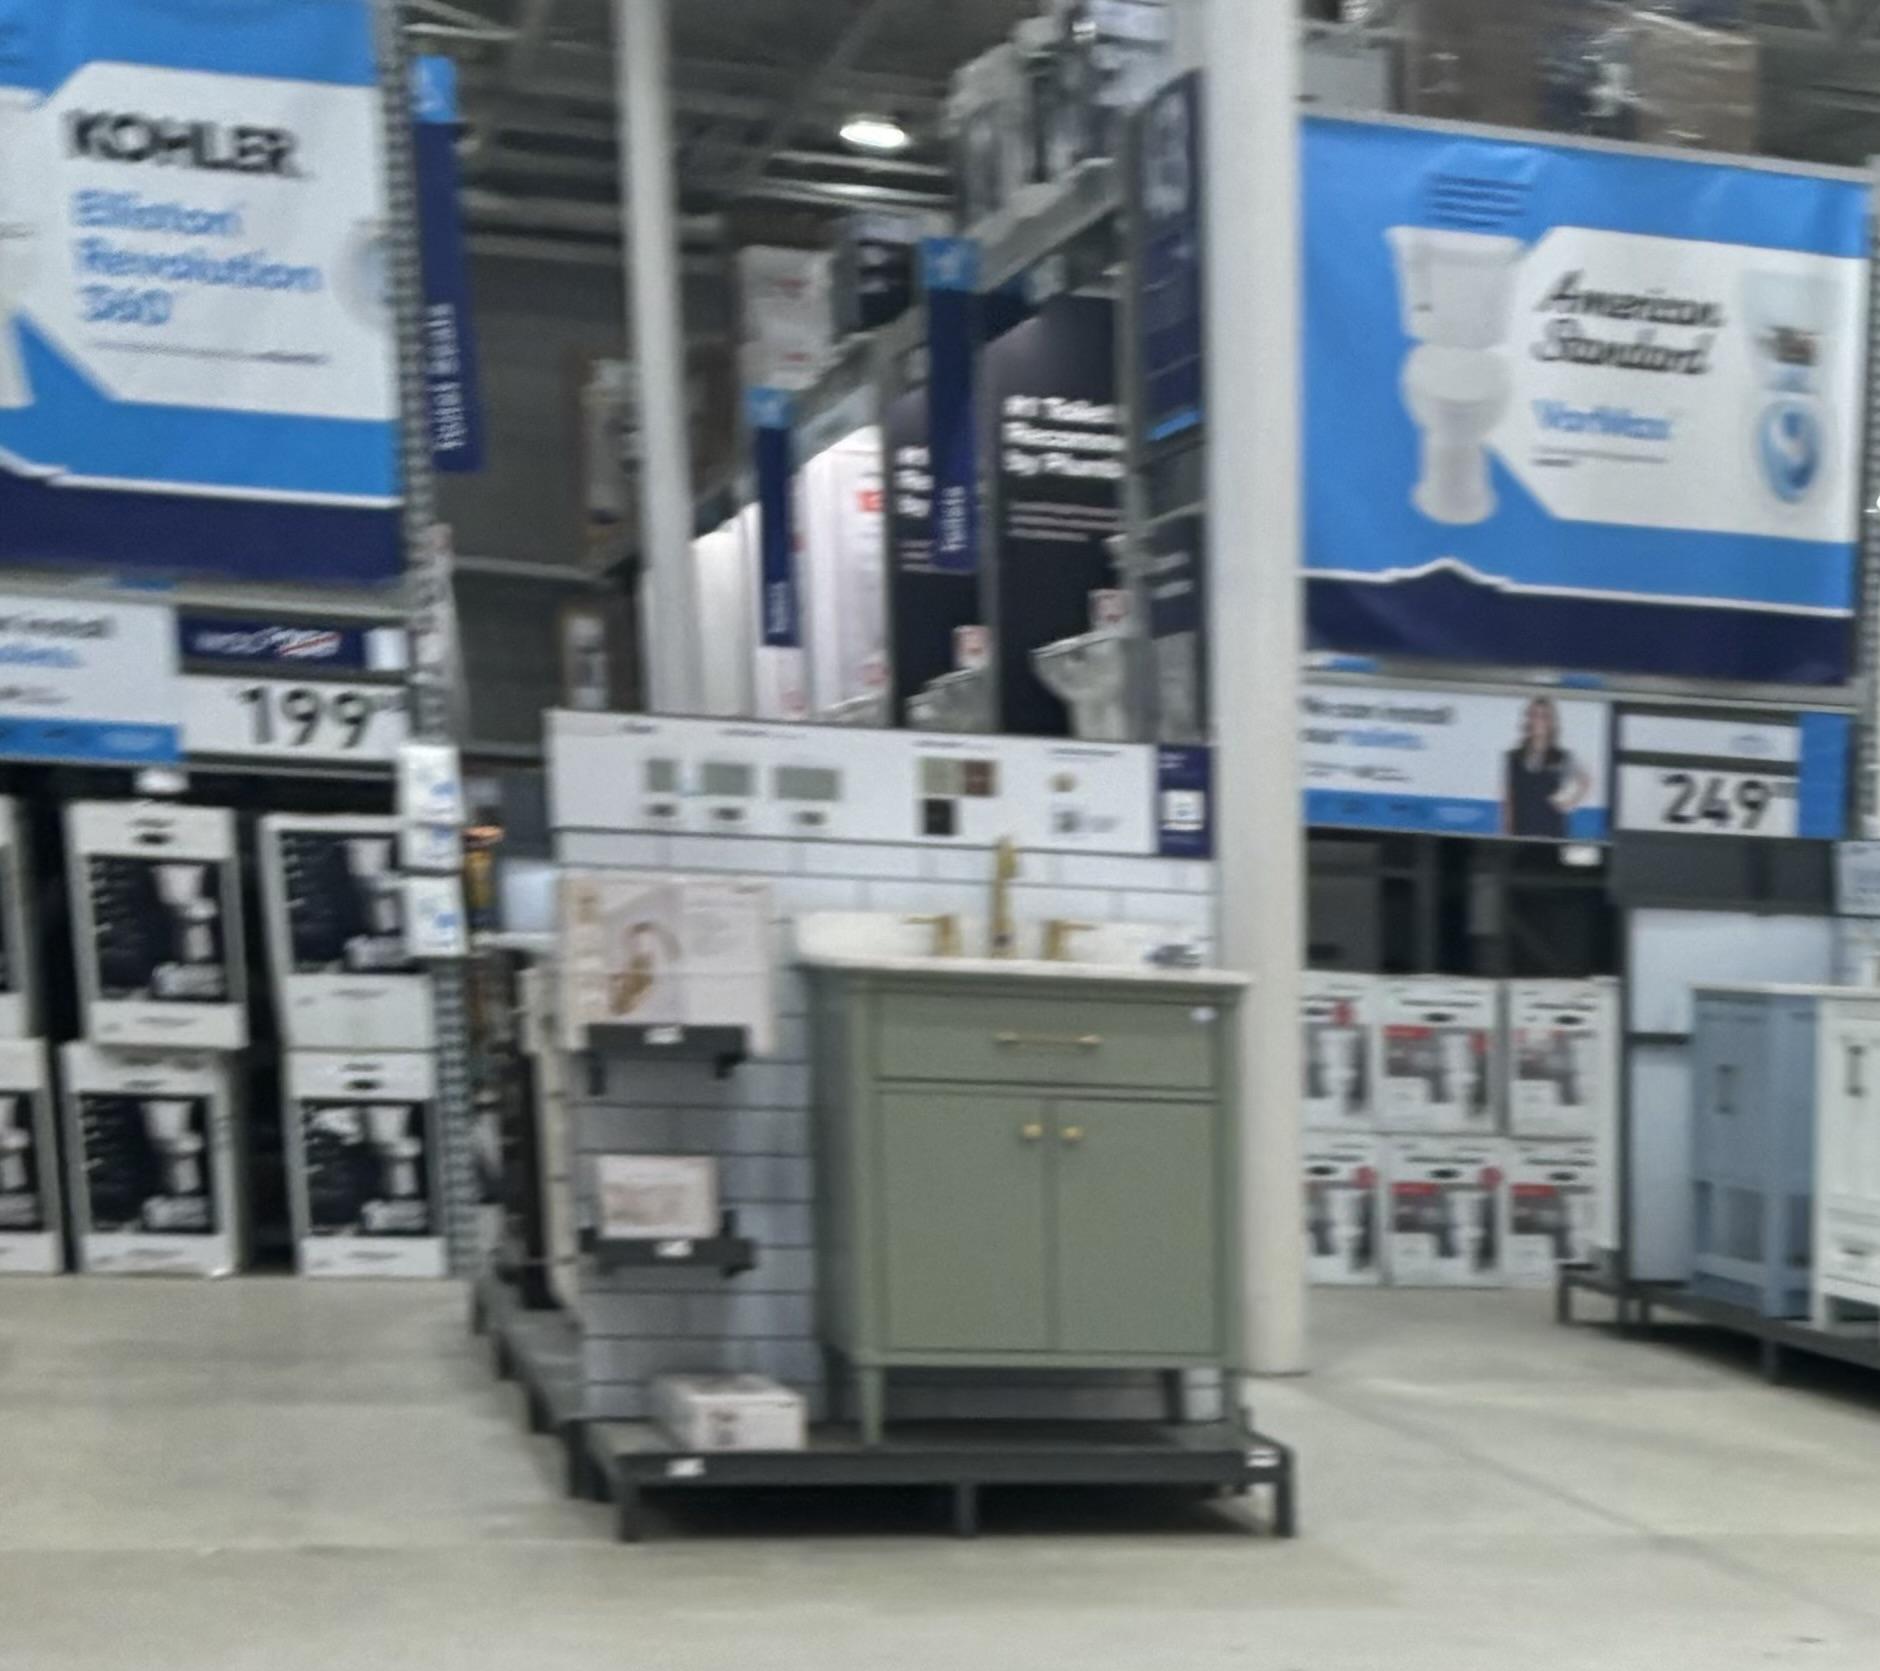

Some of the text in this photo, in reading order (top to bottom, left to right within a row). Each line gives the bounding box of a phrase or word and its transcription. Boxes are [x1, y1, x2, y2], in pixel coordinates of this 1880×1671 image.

[64, 110, 304, 179] KOHLER
[1533, 269, 1726, 327] American
[1530, 318, 1714, 375] Standard
[237, 686, 369, 749] 199
[1661, 774, 1770, 830] 249
